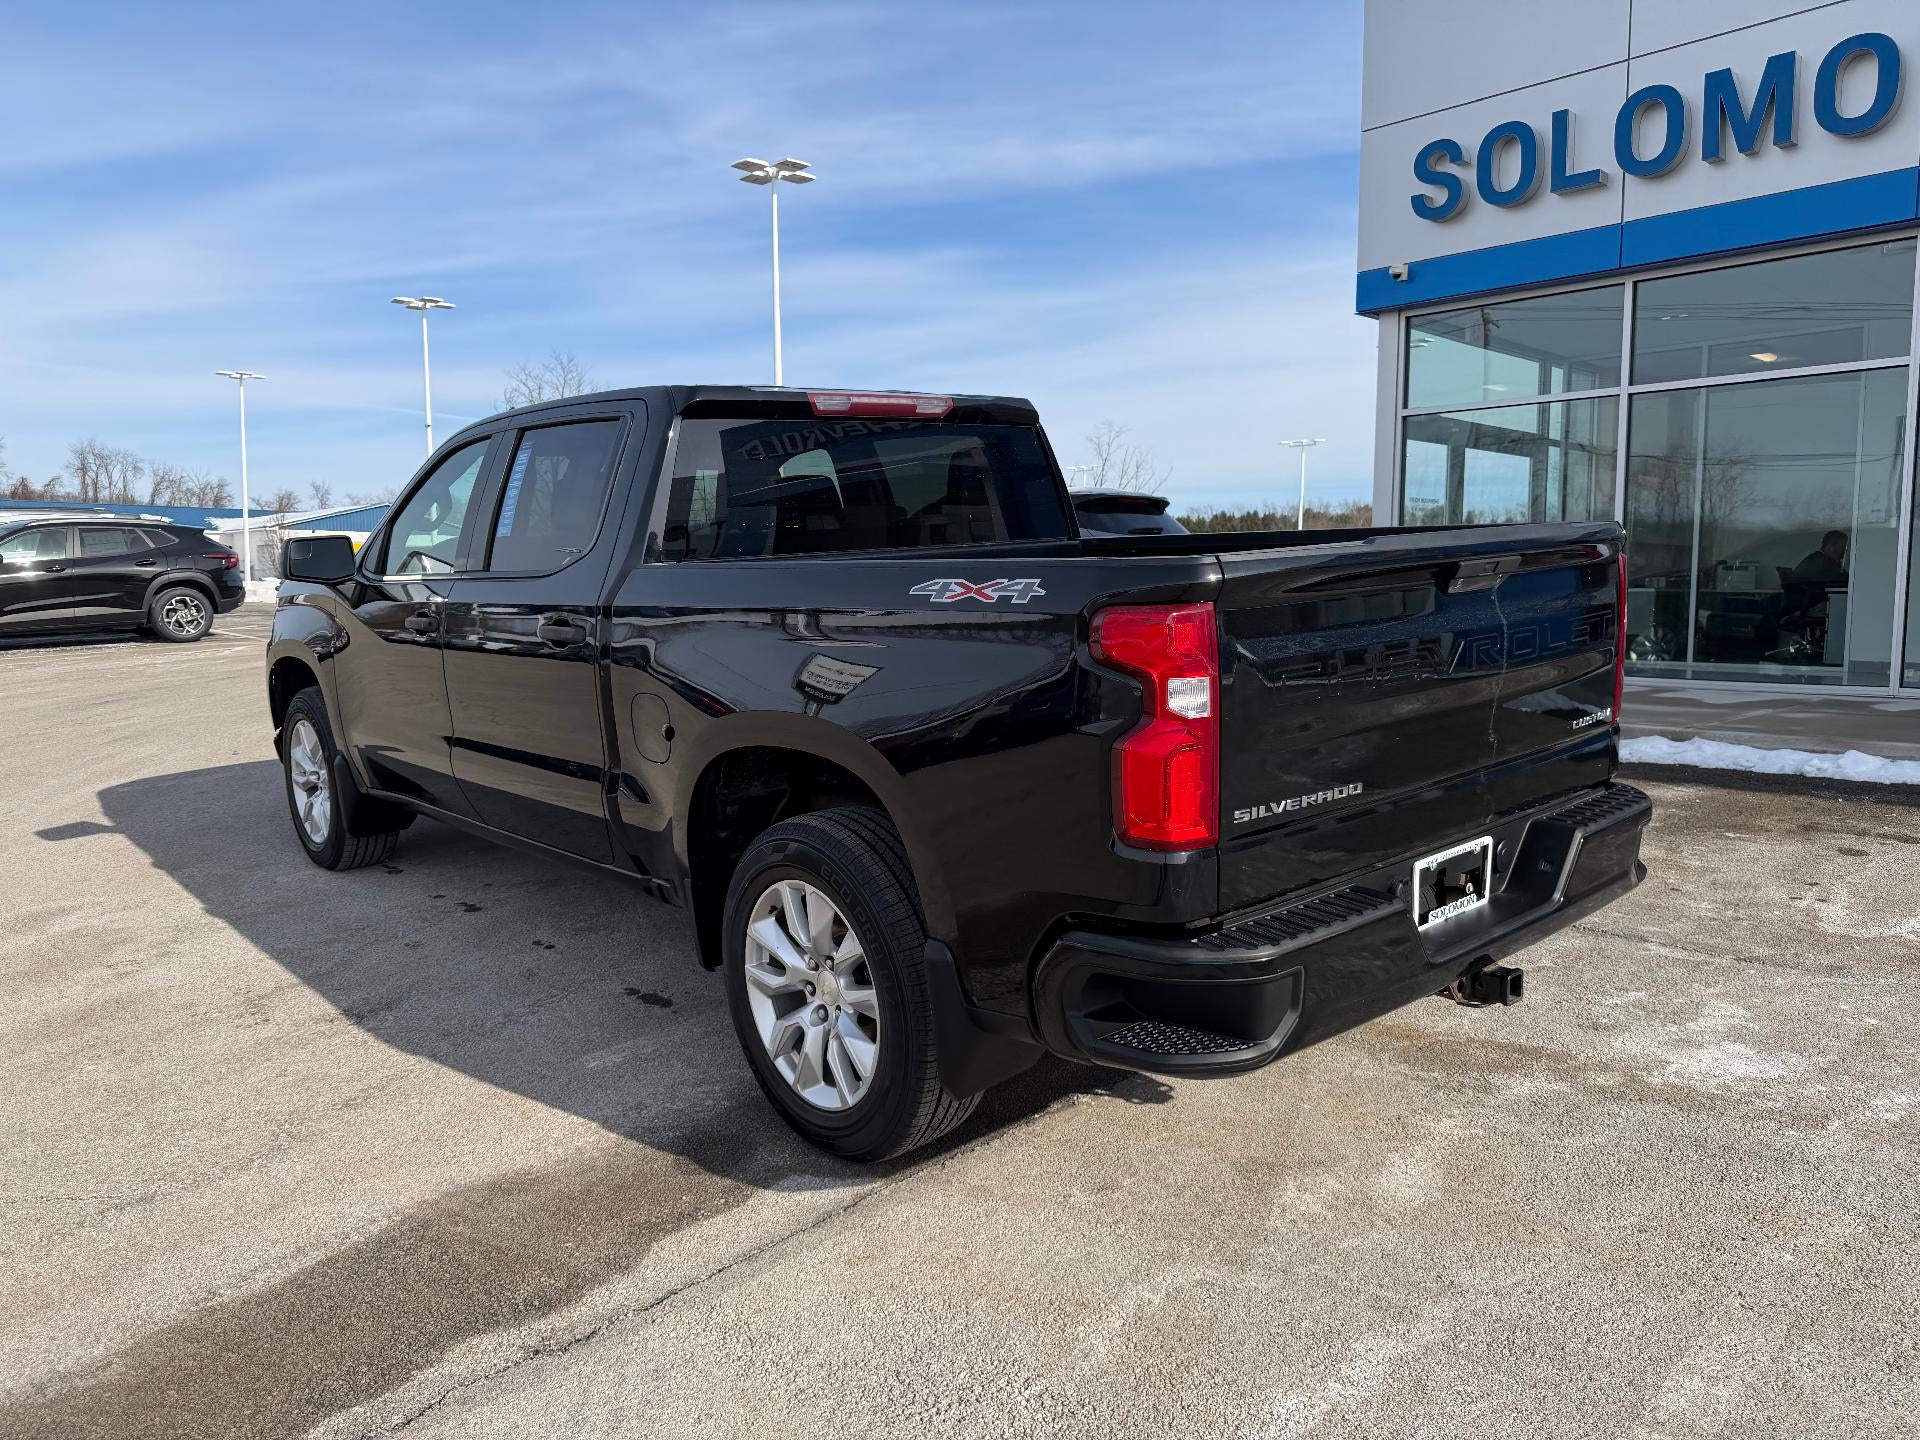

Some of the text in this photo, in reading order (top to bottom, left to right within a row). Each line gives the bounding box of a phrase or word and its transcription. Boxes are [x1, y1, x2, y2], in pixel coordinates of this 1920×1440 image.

[1410, 32, 1906, 223] SOLOMO
[1233, 782, 1364, 823] SILVERADO
[1430, 894, 1477, 922] SOLOMON
